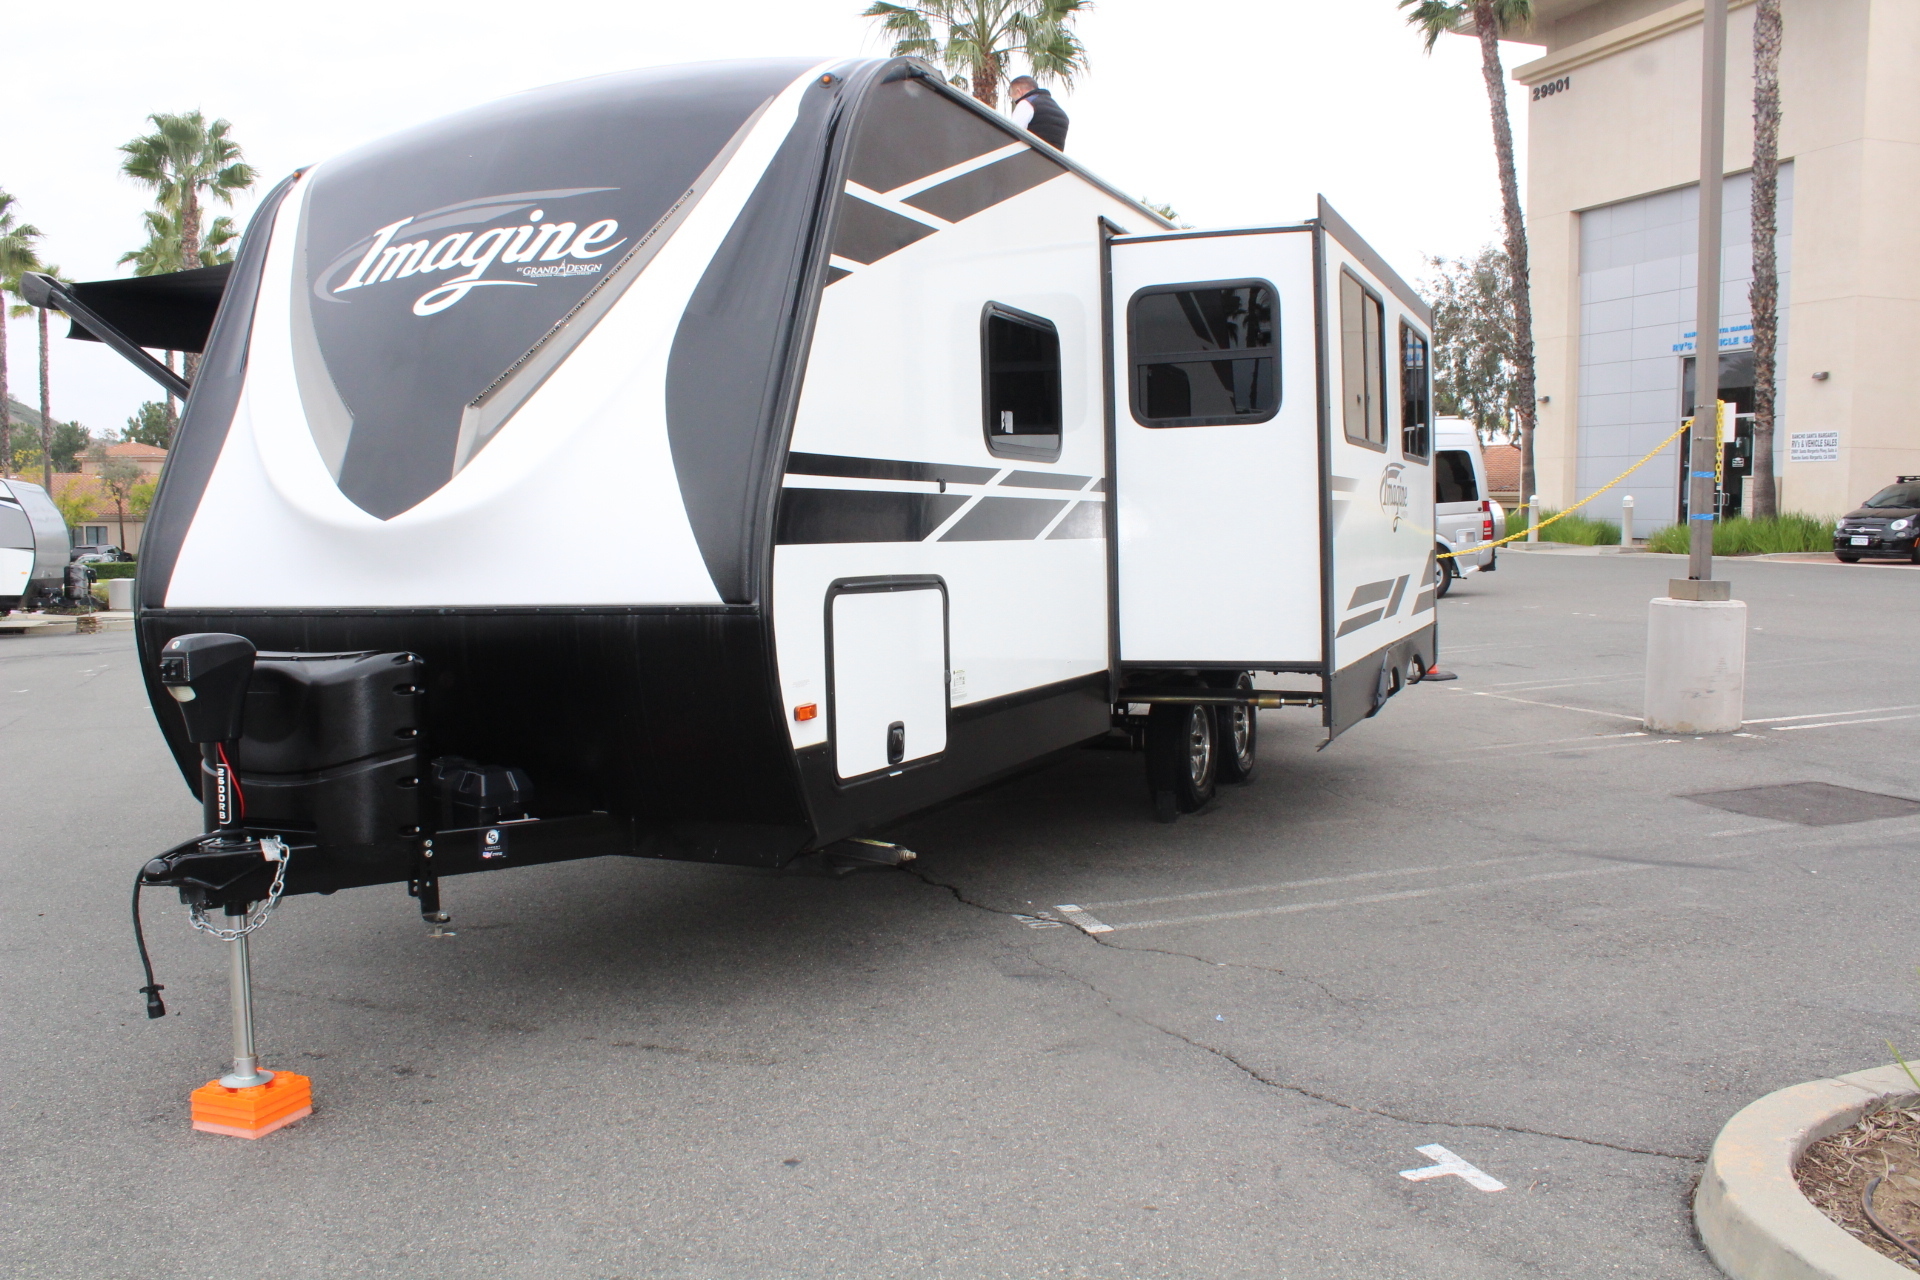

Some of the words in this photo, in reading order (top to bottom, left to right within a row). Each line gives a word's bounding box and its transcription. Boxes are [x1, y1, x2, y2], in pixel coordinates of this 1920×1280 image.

[1533, 76, 1570, 101] 29901
[333, 209, 628, 316] Imagine
[522, 266, 557, 275] GRAND
[566, 263, 602, 273] DESIGN
[1672, 342, 1693, 352] RV'S
[1719, 337, 1739, 347] ICLE
[1805, 439, 1823, 448] VEHICLE
[1824, 438, 1837, 447] SALES
[217, 768, 226, 819] 2600RB
